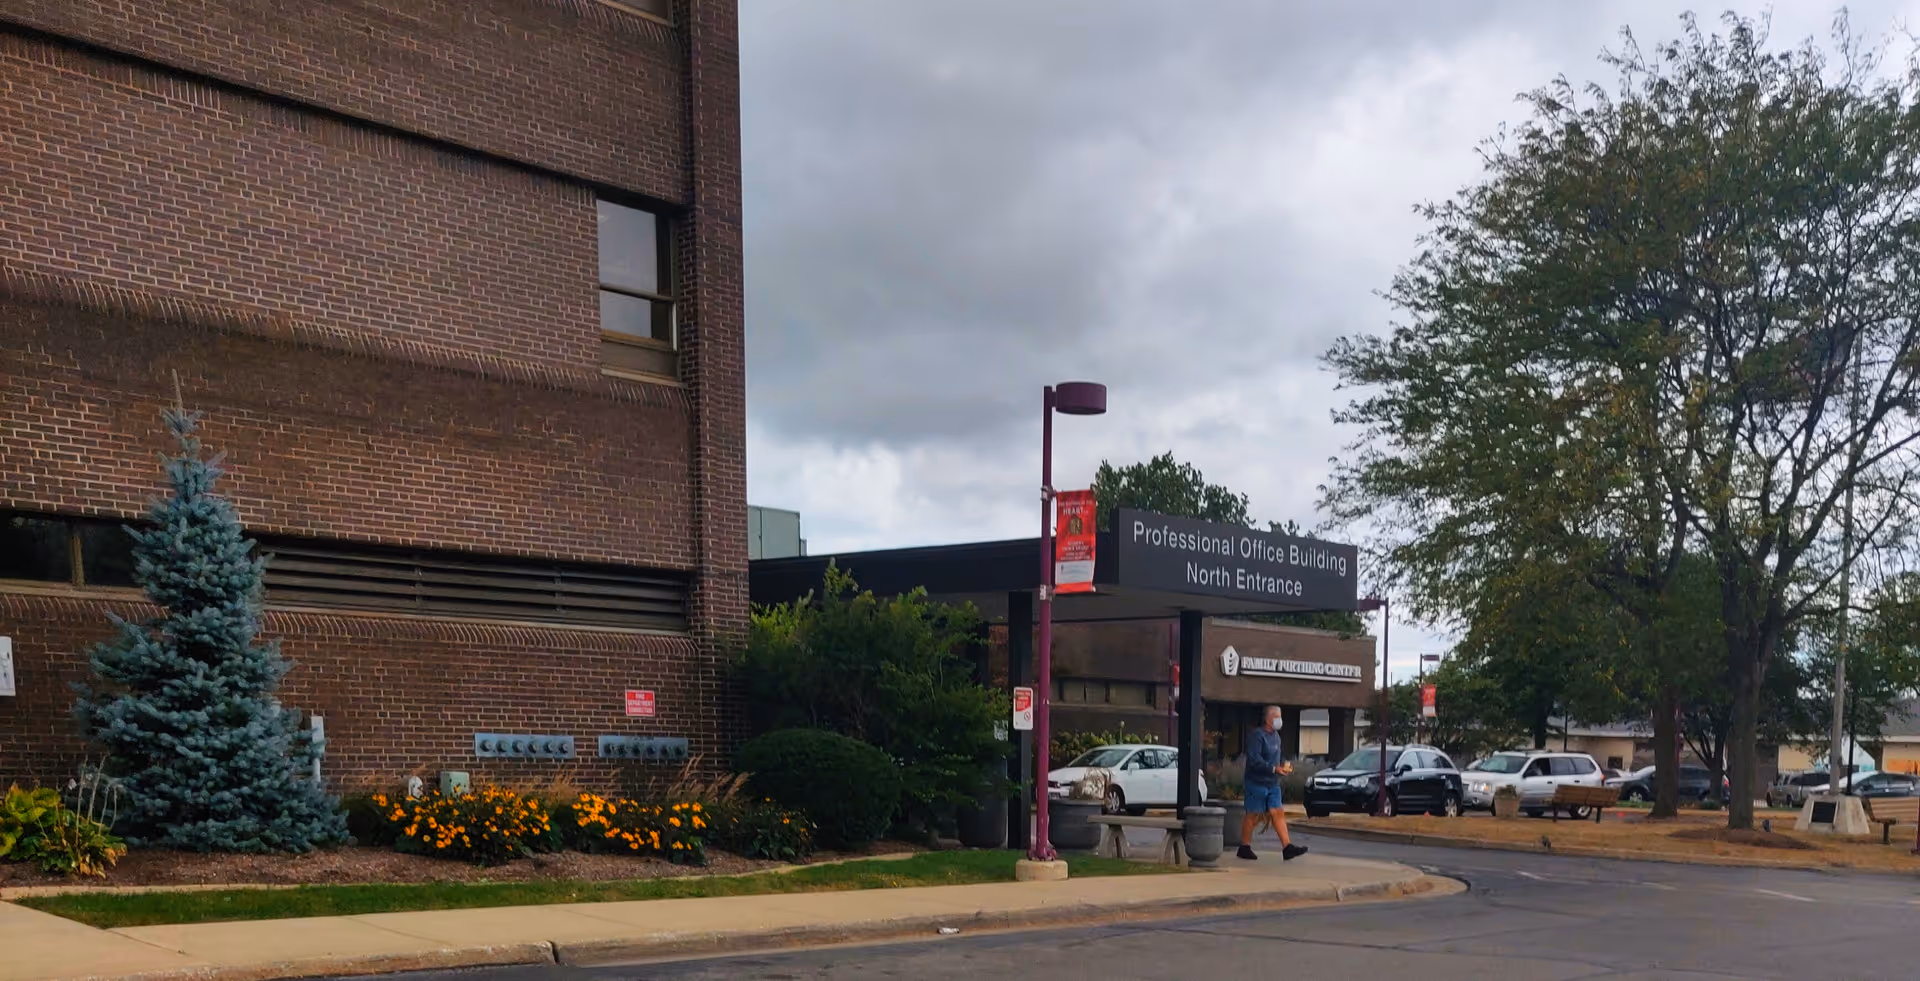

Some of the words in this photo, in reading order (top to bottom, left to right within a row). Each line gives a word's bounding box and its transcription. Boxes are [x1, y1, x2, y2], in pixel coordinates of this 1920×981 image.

[1133, 520, 1234, 557] Professional
[1240, 537, 1284, 563] Office
[1289, 545, 1347, 577] Building
[1187, 562, 1230, 588] North
[1236, 568, 1302, 597] Entrance
[1242, 656, 1278, 671] FAMILY
[1325, 663, 1361, 677] CENTER
